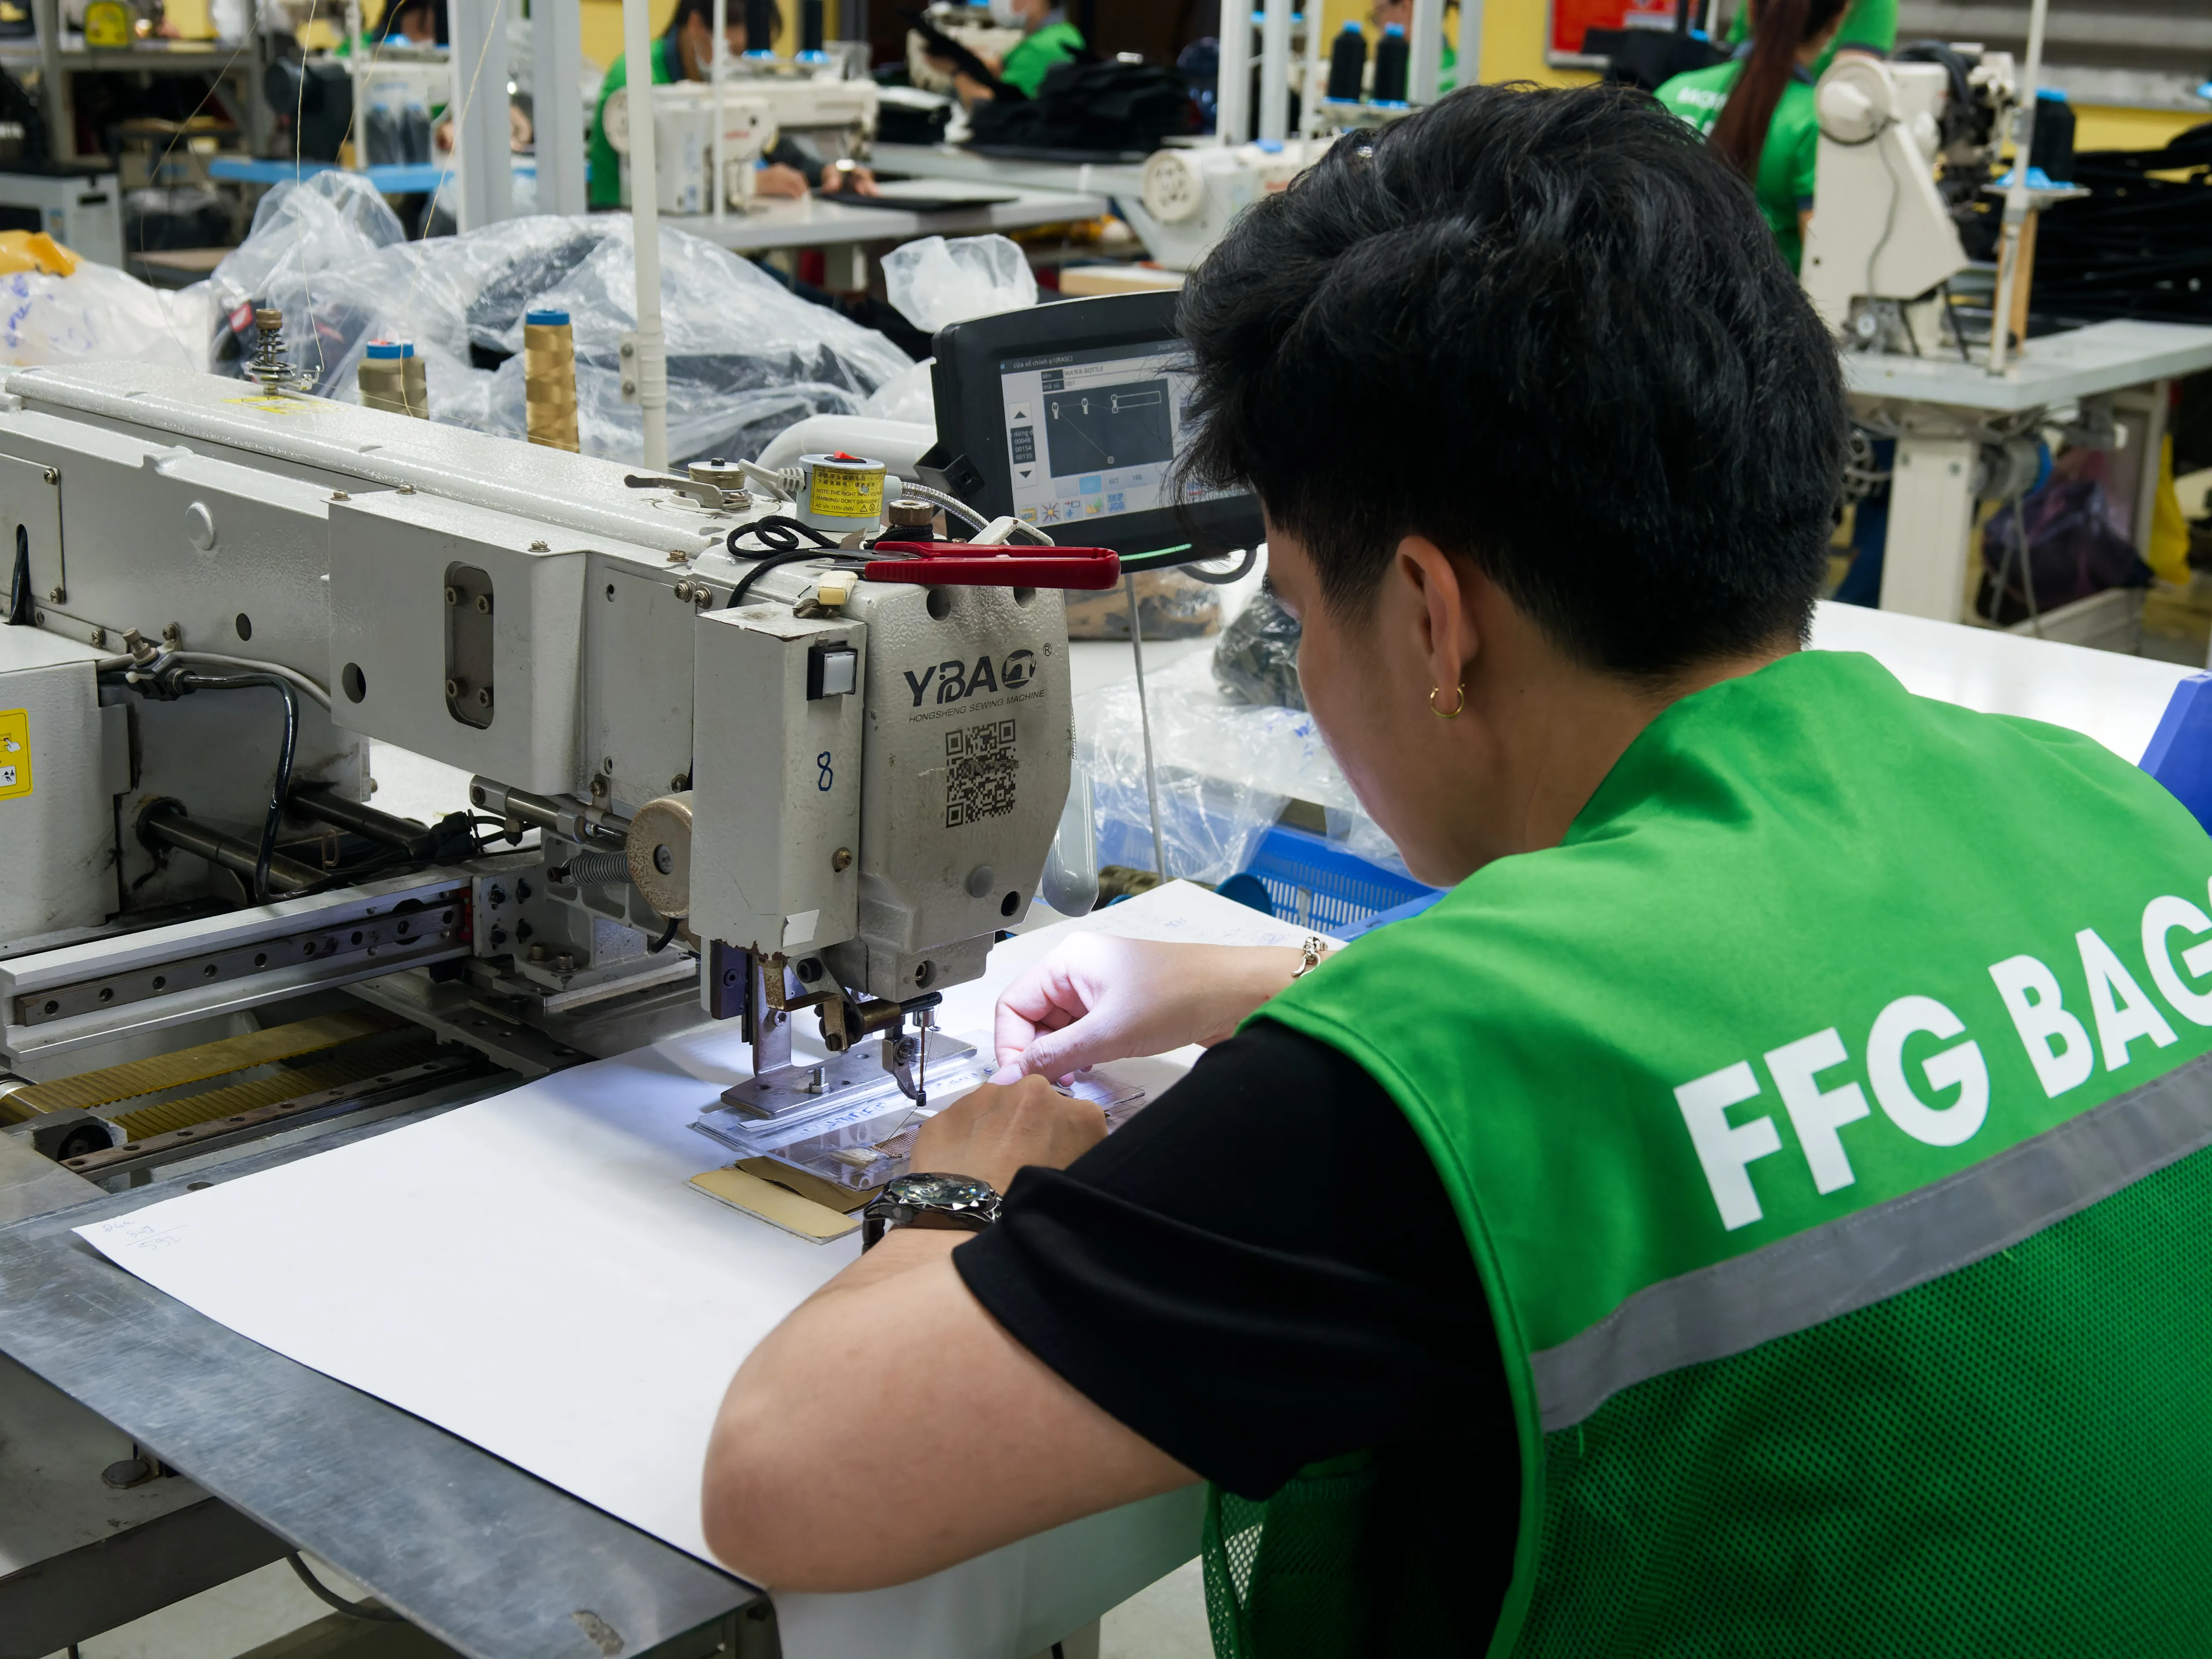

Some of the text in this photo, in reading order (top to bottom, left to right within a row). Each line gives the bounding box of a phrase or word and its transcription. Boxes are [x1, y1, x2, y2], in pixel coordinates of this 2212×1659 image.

[909, 689, 1045, 724] HONGSHENG SEWING MACHINE
[817, 751, 833, 792] 8
[1673, 875, 2212, 1231] FFG BAG
